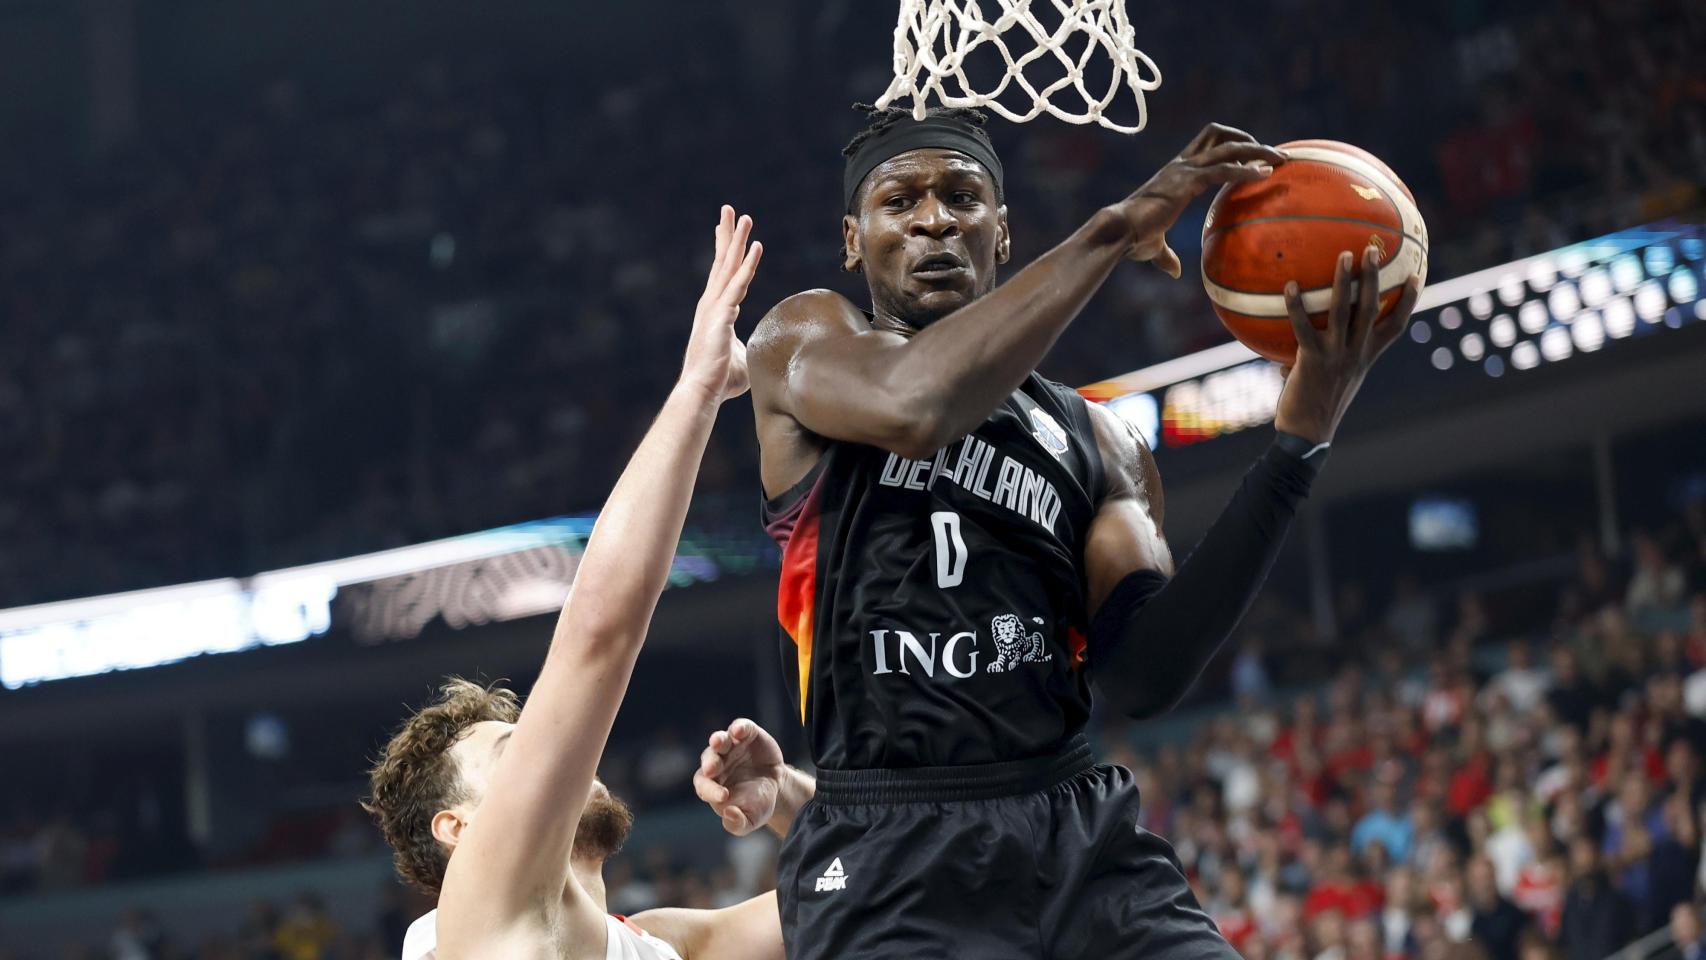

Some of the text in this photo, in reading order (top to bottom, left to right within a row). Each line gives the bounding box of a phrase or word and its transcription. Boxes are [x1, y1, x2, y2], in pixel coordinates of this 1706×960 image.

[879, 433, 1062, 536] DEHLAND
[931, 511, 968, 588] 0
[869, 630, 980, 679] ING
